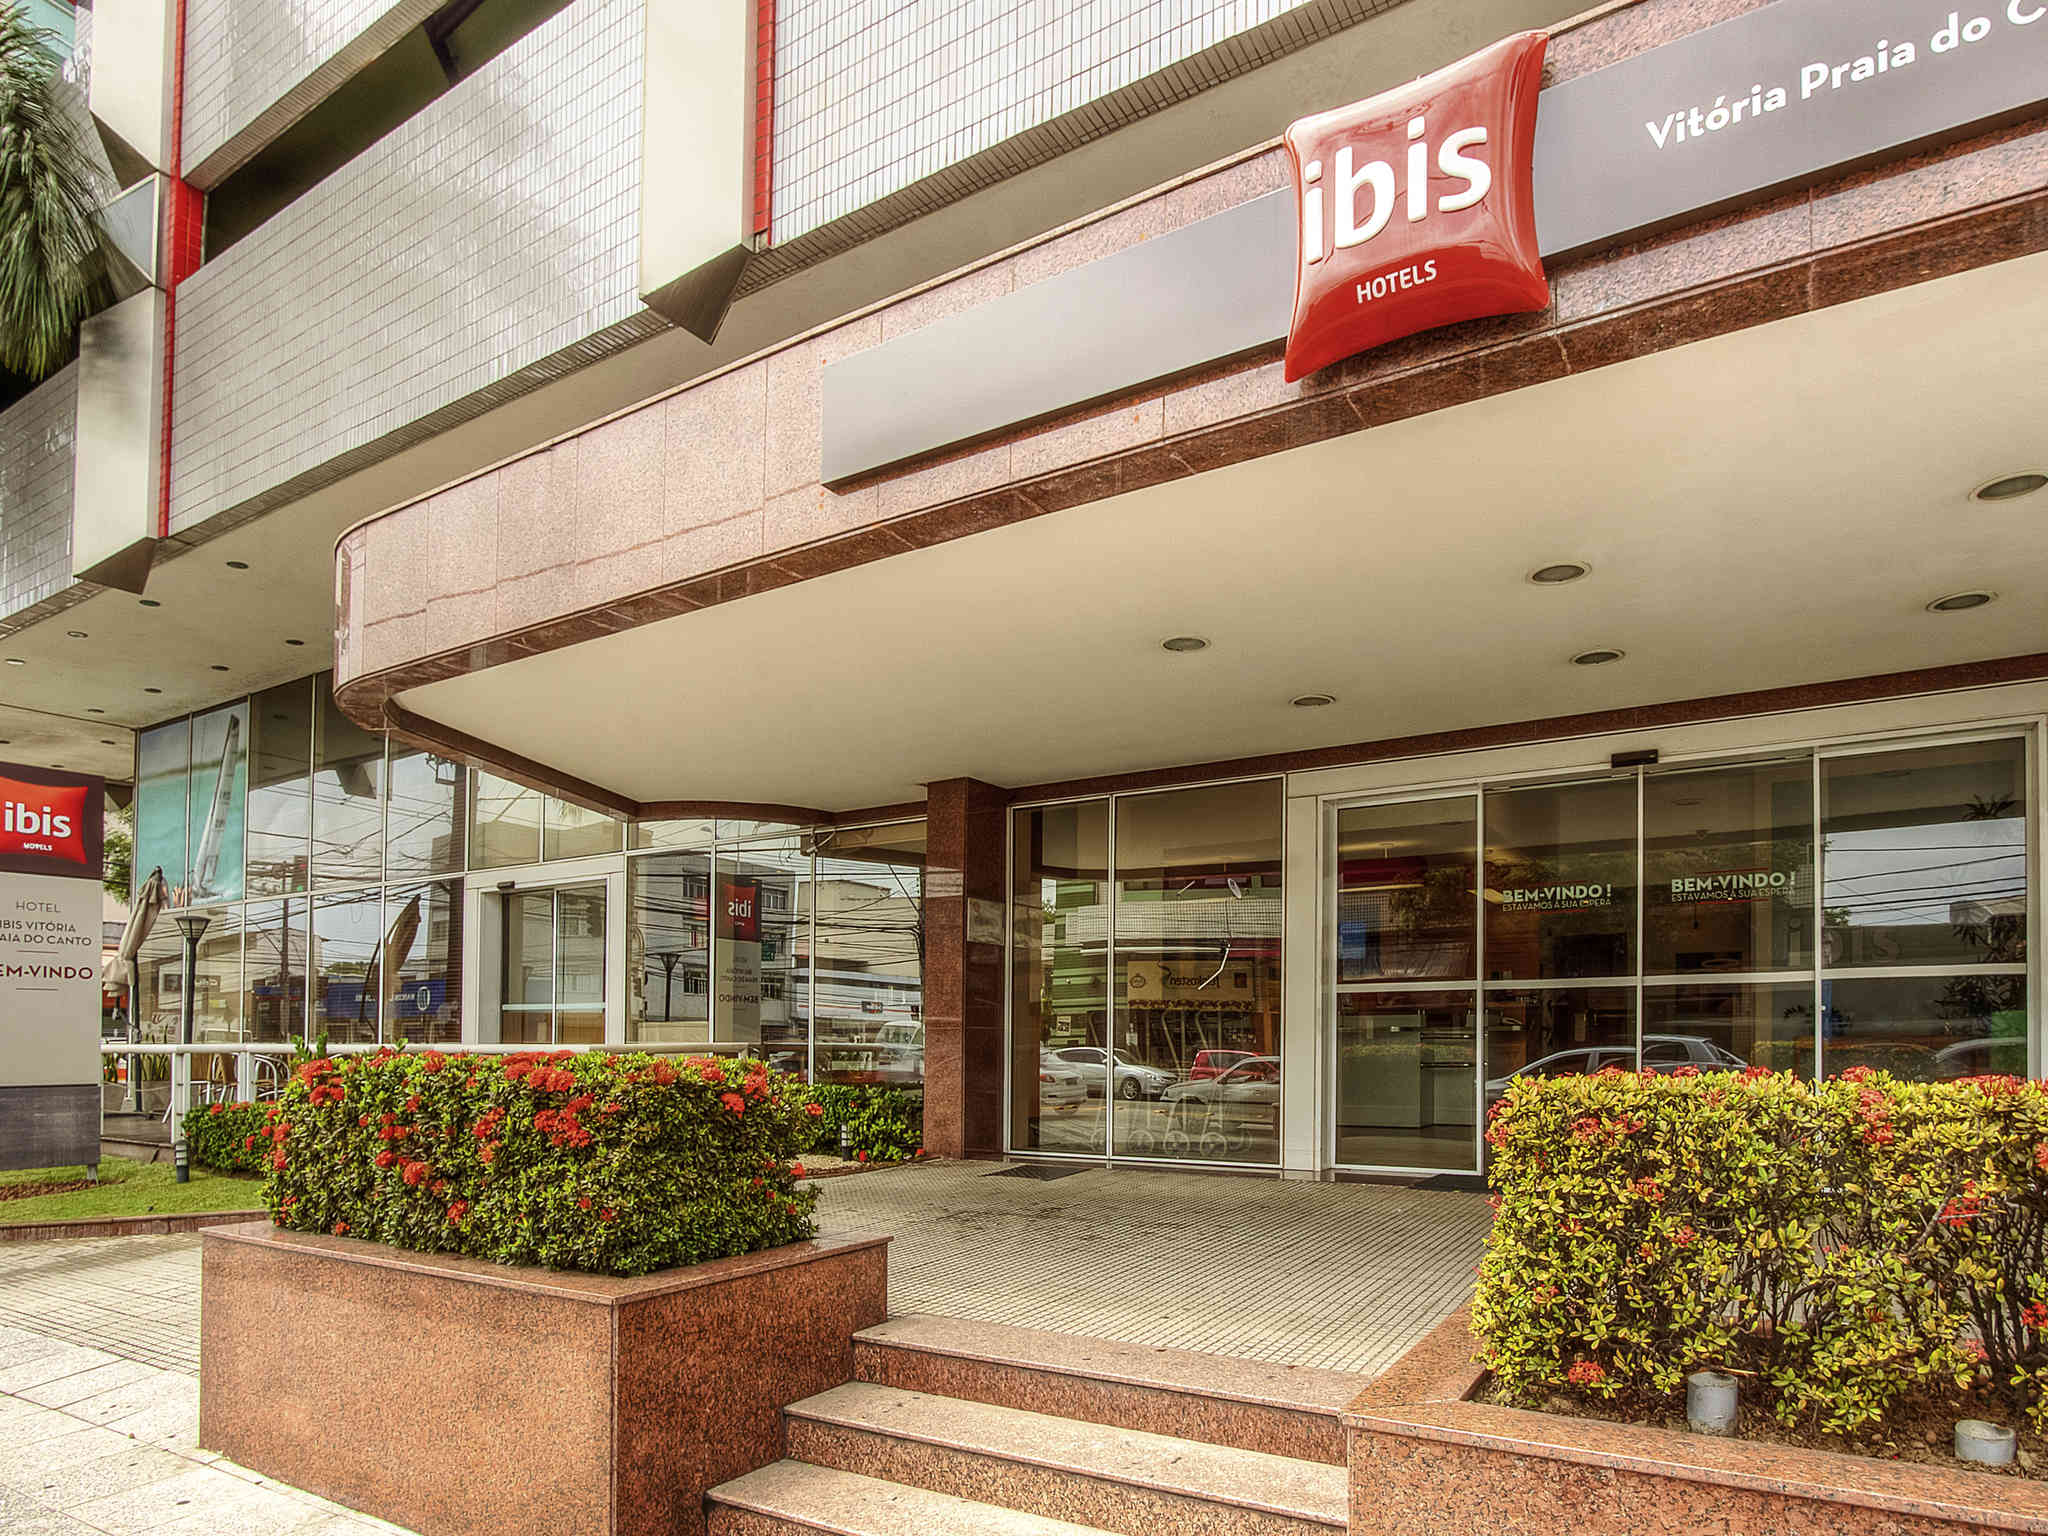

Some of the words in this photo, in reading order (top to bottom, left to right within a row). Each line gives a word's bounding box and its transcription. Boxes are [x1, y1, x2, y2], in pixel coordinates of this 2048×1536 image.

[1645, 84, 1787, 149] Vitória
[1800, 39, 1916, 100] Praia
[1930, 12, 1992, 54] do
[1304, 115, 1492, 266] ibis
[1356, 259, 1438, 304] HOTELS
[4, 800, 73, 839] ibis
[15, 901, 62, 913] HOTEL
[24, 933, 44, 944] DO
[46, 935, 92, 947] CANTO
